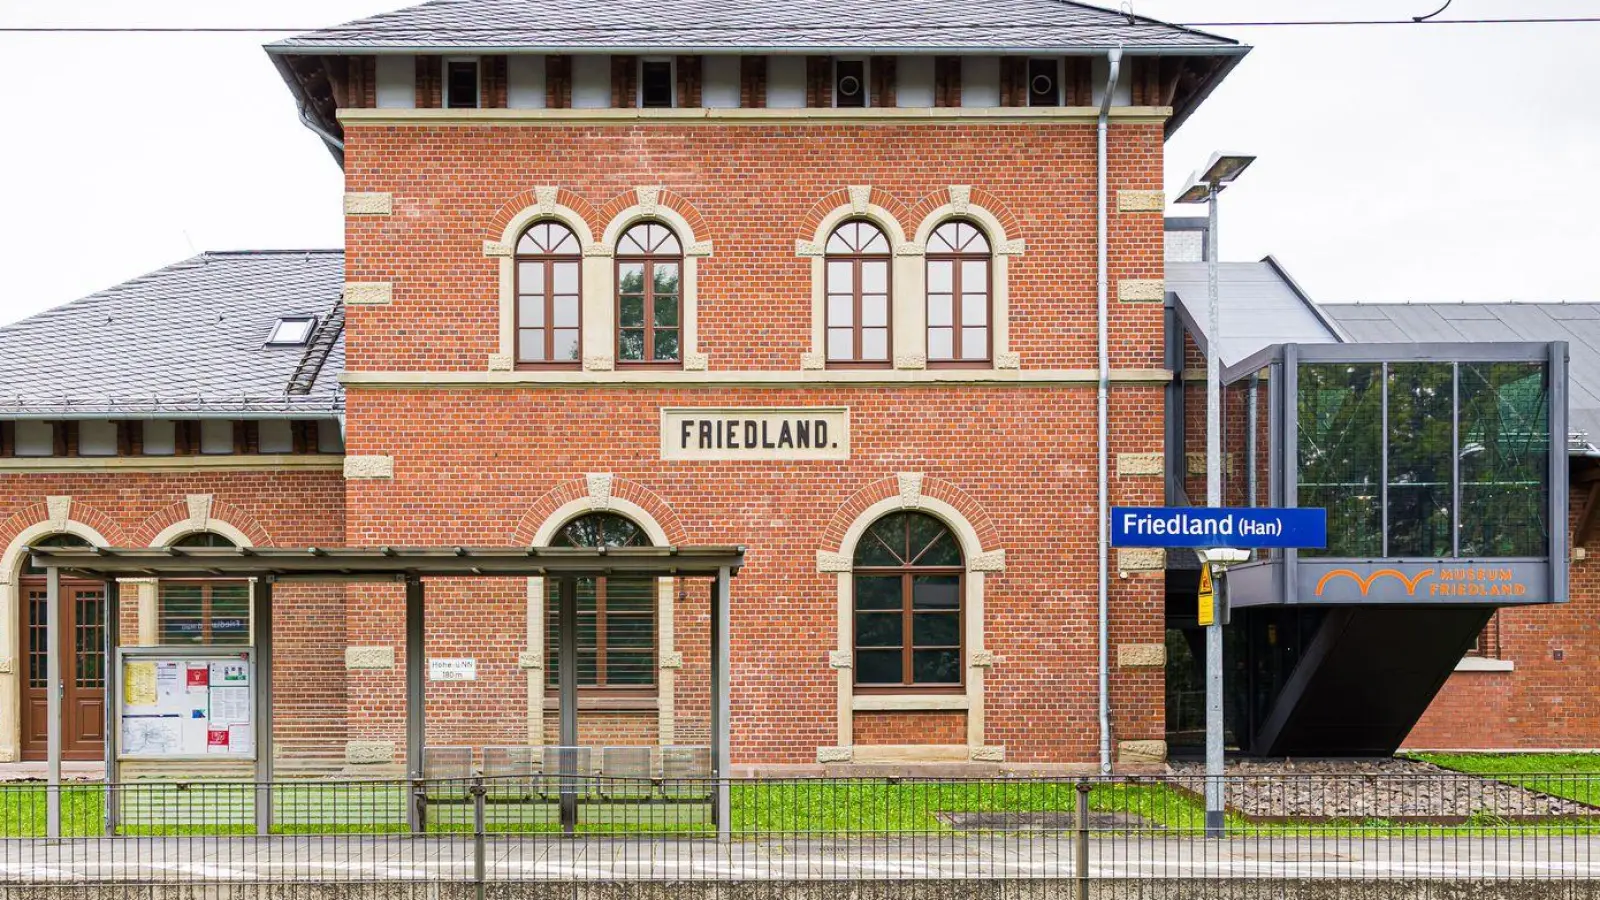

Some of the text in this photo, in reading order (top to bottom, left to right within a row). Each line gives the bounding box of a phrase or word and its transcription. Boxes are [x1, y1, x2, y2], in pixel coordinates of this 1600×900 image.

[681, 419, 838, 449] FRIEDLAND.
[1123, 513, 1282, 537] Friedland (Han)
[1440, 568, 1512, 581] MUSEUM
[1429, 583, 1526, 597] FRIEDLAND
